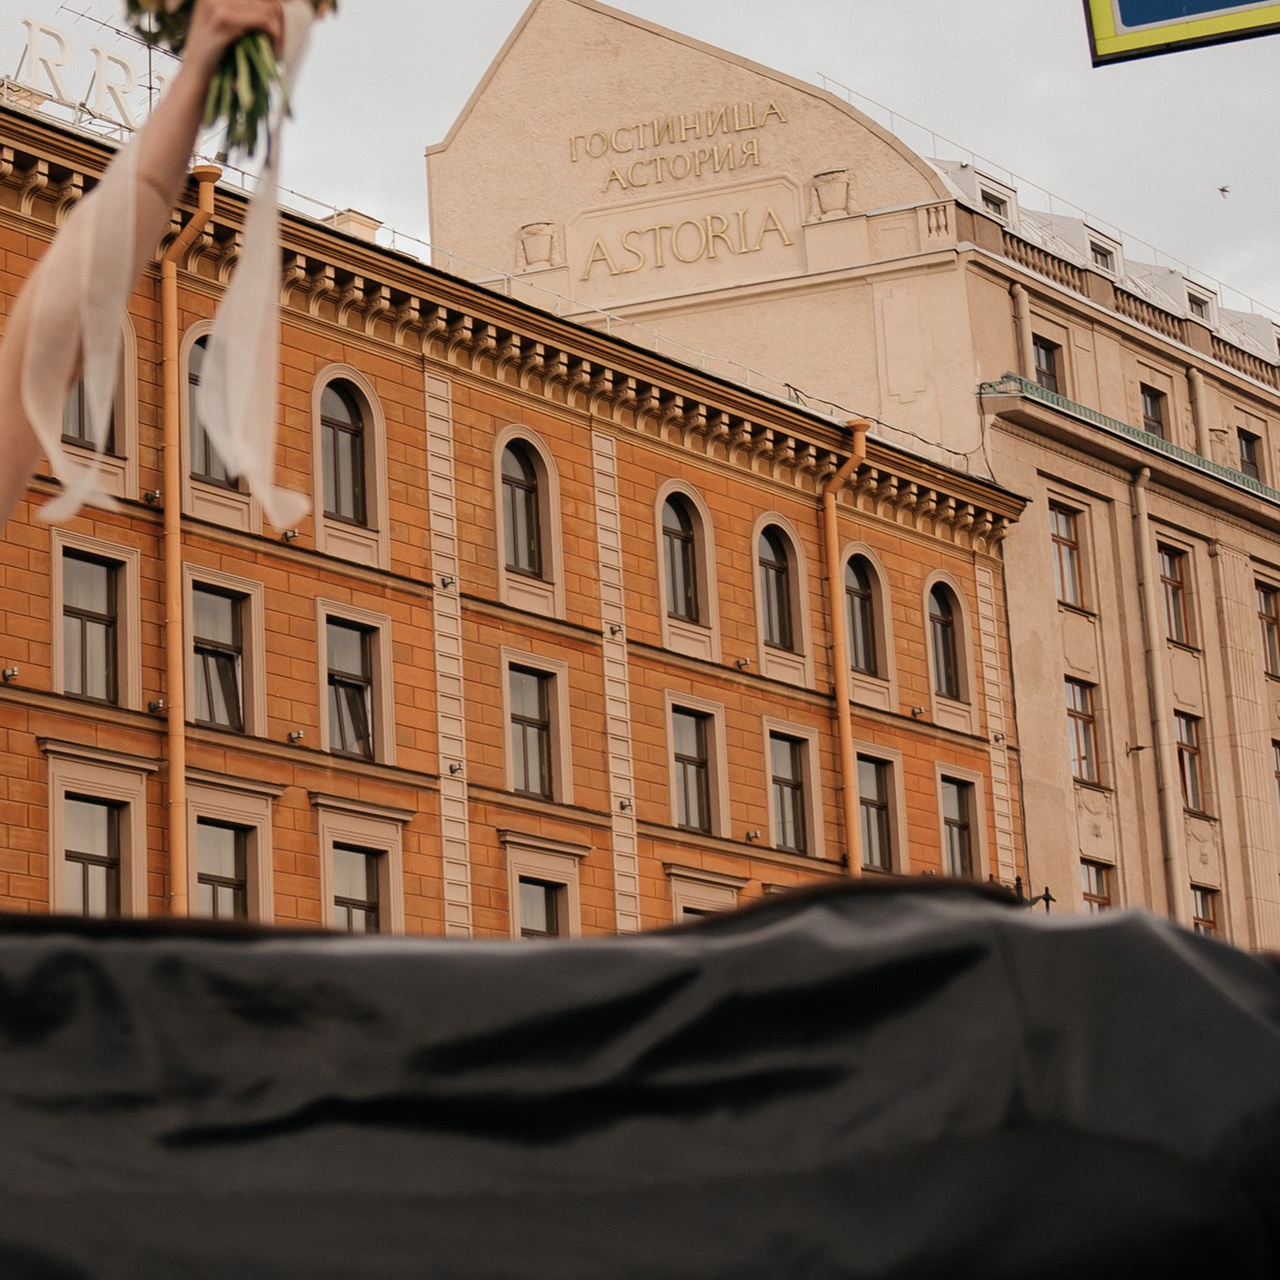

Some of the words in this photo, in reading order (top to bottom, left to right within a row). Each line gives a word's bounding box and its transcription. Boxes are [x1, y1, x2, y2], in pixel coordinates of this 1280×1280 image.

[569, 99, 788, 162] ГОСТИНИЦА
[601, 138, 760, 193] АСТОРИЯ
[580, 206, 794, 281] ASTORIA
